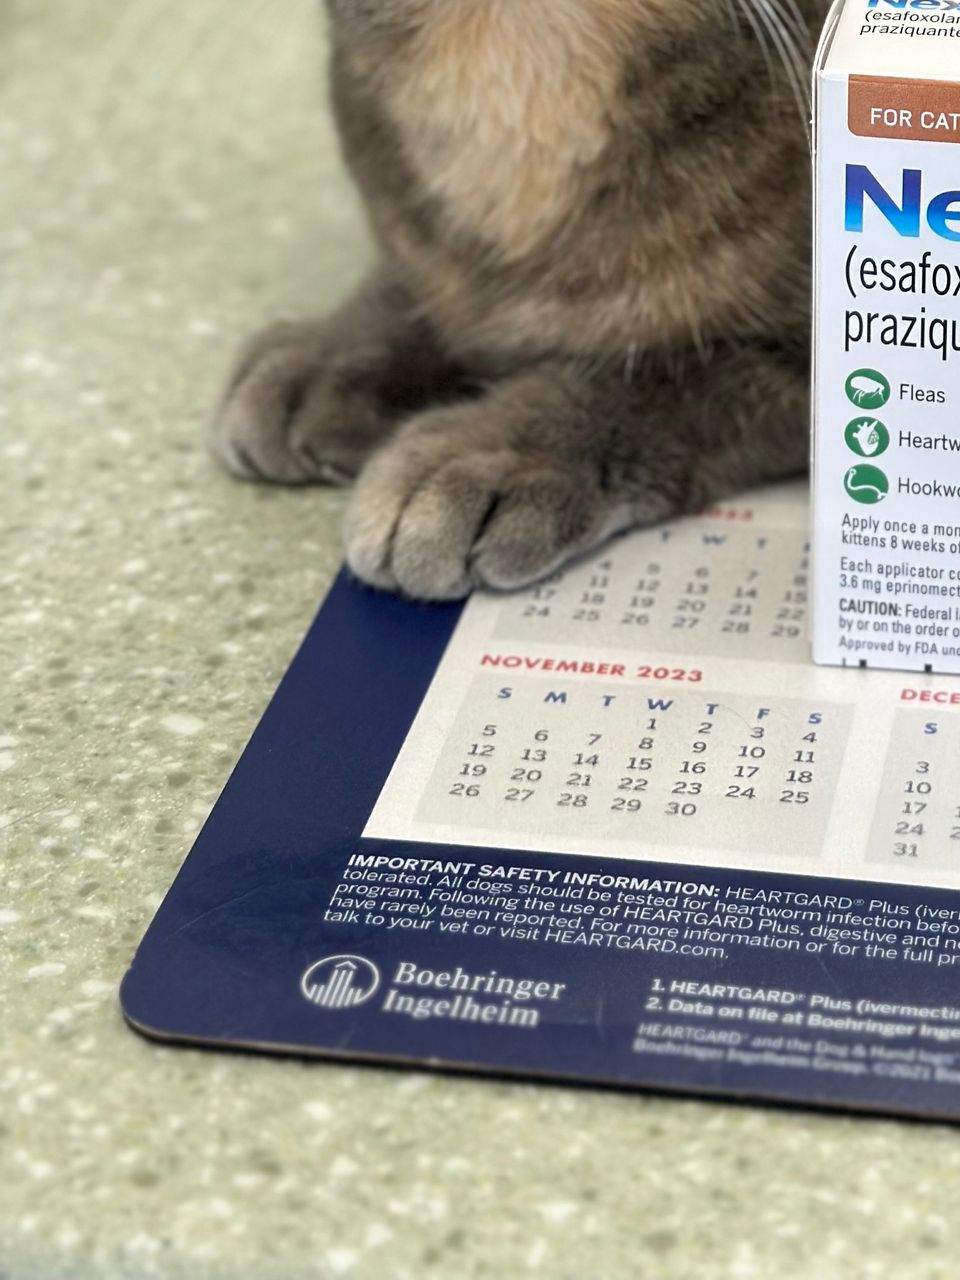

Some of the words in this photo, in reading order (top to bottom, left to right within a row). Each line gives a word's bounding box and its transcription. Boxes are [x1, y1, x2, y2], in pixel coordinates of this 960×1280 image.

[870, 108, 913, 127] FOR
[899, 383, 945, 404] Fleas
[842, 513, 879, 532] Apply
[884, 520, 917, 533] once
[921, 525, 929, 535] a
[842, 530, 886, 548] kittens
[891, 535, 898, 548] 8
[902, 538, 945, 553] weeks
[840, 557, 872, 570] Each
[877, 563, 944, 579] applicator
[840, 574, 858, 588] 3.6
[862, 579, 881, 594] mg
[839, 598, 901, 616] CAUTION:
[905, 604, 951, 620] Federal
[839, 616, 853, 632] by
[857, 620, 869, 630] or
[873, 622, 888, 632] on
[892, 620, 911, 634] the
[915, 623, 949, 636] order
[839, 636, 893, 652] Approved
[898, 641, 911, 654] by
[915, 641, 938, 654] FDA
[480, 654, 625, 677] NOVEMBER
[637, 666, 703, 682] 2023
[482, 724, 496, 737] 5
[534, 730, 549, 742] 6
[589, 734, 602, 746] 7
[639, 737, 653, 750] 8
[693, 741, 707, 754] 9
[738, 745, 765, 759] 10
[794, 750, 816, 763] 11
[905, 781, 931, 794] 10
[348, 854, 475, 875] IMPORTANT
[478, 864, 560, 882] SAFETY
[564, 871, 720, 897] INFORMATION:
[869, 900, 909, 915] Plus
[343, 868, 432, 886] tolerated.
[438, 876, 462, 888] All
[466, 878, 512, 893] dogs
[518, 883, 583, 898] should
[588, 889, 611, 901] be
[618, 893, 678, 907] tested
[683, 898, 710, 909] for
[714, 899, 821, 921] heartworm
[827, 911, 911, 930] infection
[323, 909, 359, 923] talk
[365, 914, 384, 925] to
[387, 916, 434, 929] your
[440, 921, 468, 933] vet
[474, 924, 495, 935] or
[500, 927, 540, 940] visit
[544, 930, 729, 959] HEARTGARD.com.
[393, 962, 566, 1001] Boehringer
[382, 989, 540, 1027] Ingelheim
